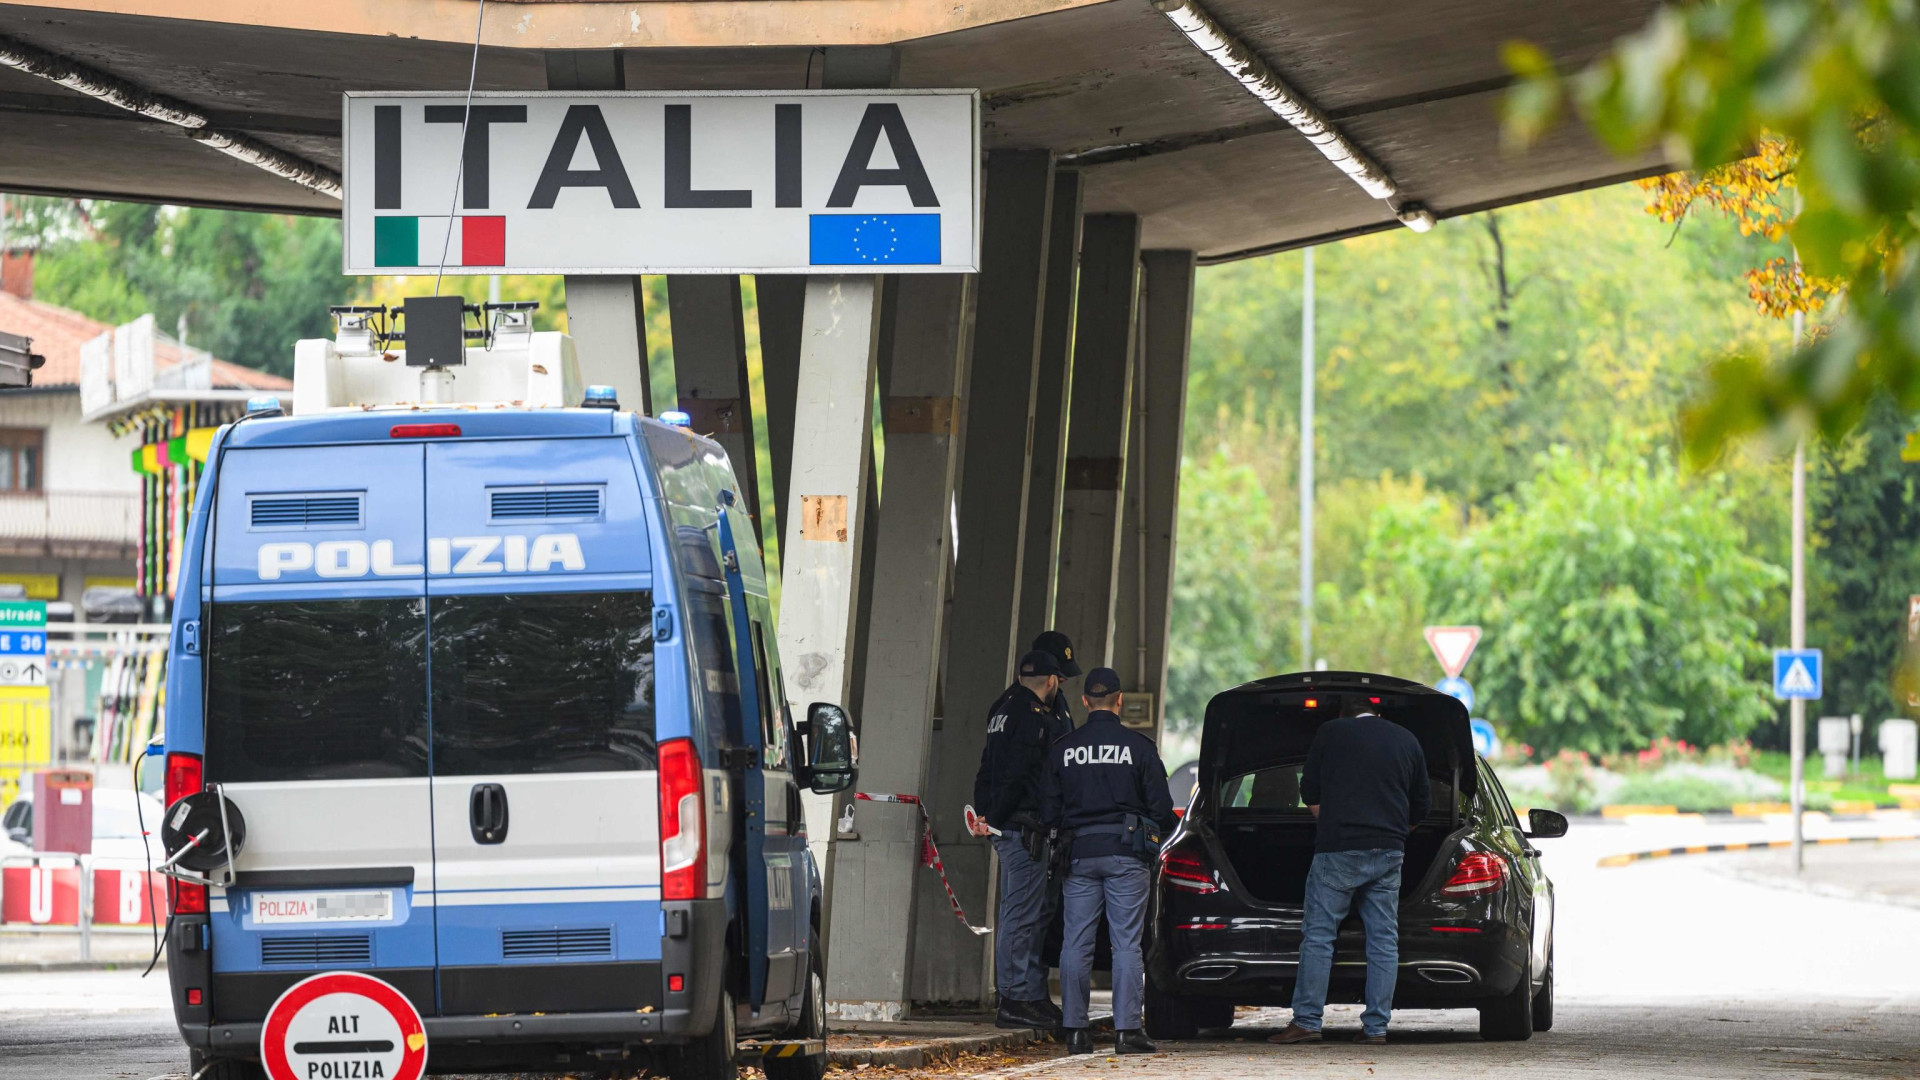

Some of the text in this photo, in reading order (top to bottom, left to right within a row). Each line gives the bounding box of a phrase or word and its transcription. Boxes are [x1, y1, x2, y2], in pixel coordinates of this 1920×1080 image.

[374, 103, 941, 209] ITALIA
[258, 533, 586, 580] POLIZIA
[1063, 745, 1133, 767] POLIZIA
[259, 901, 308, 917] POLIZIA
[328, 1015, 360, 1034] ALT
[308, 1060, 384, 1079] POLIZIA
